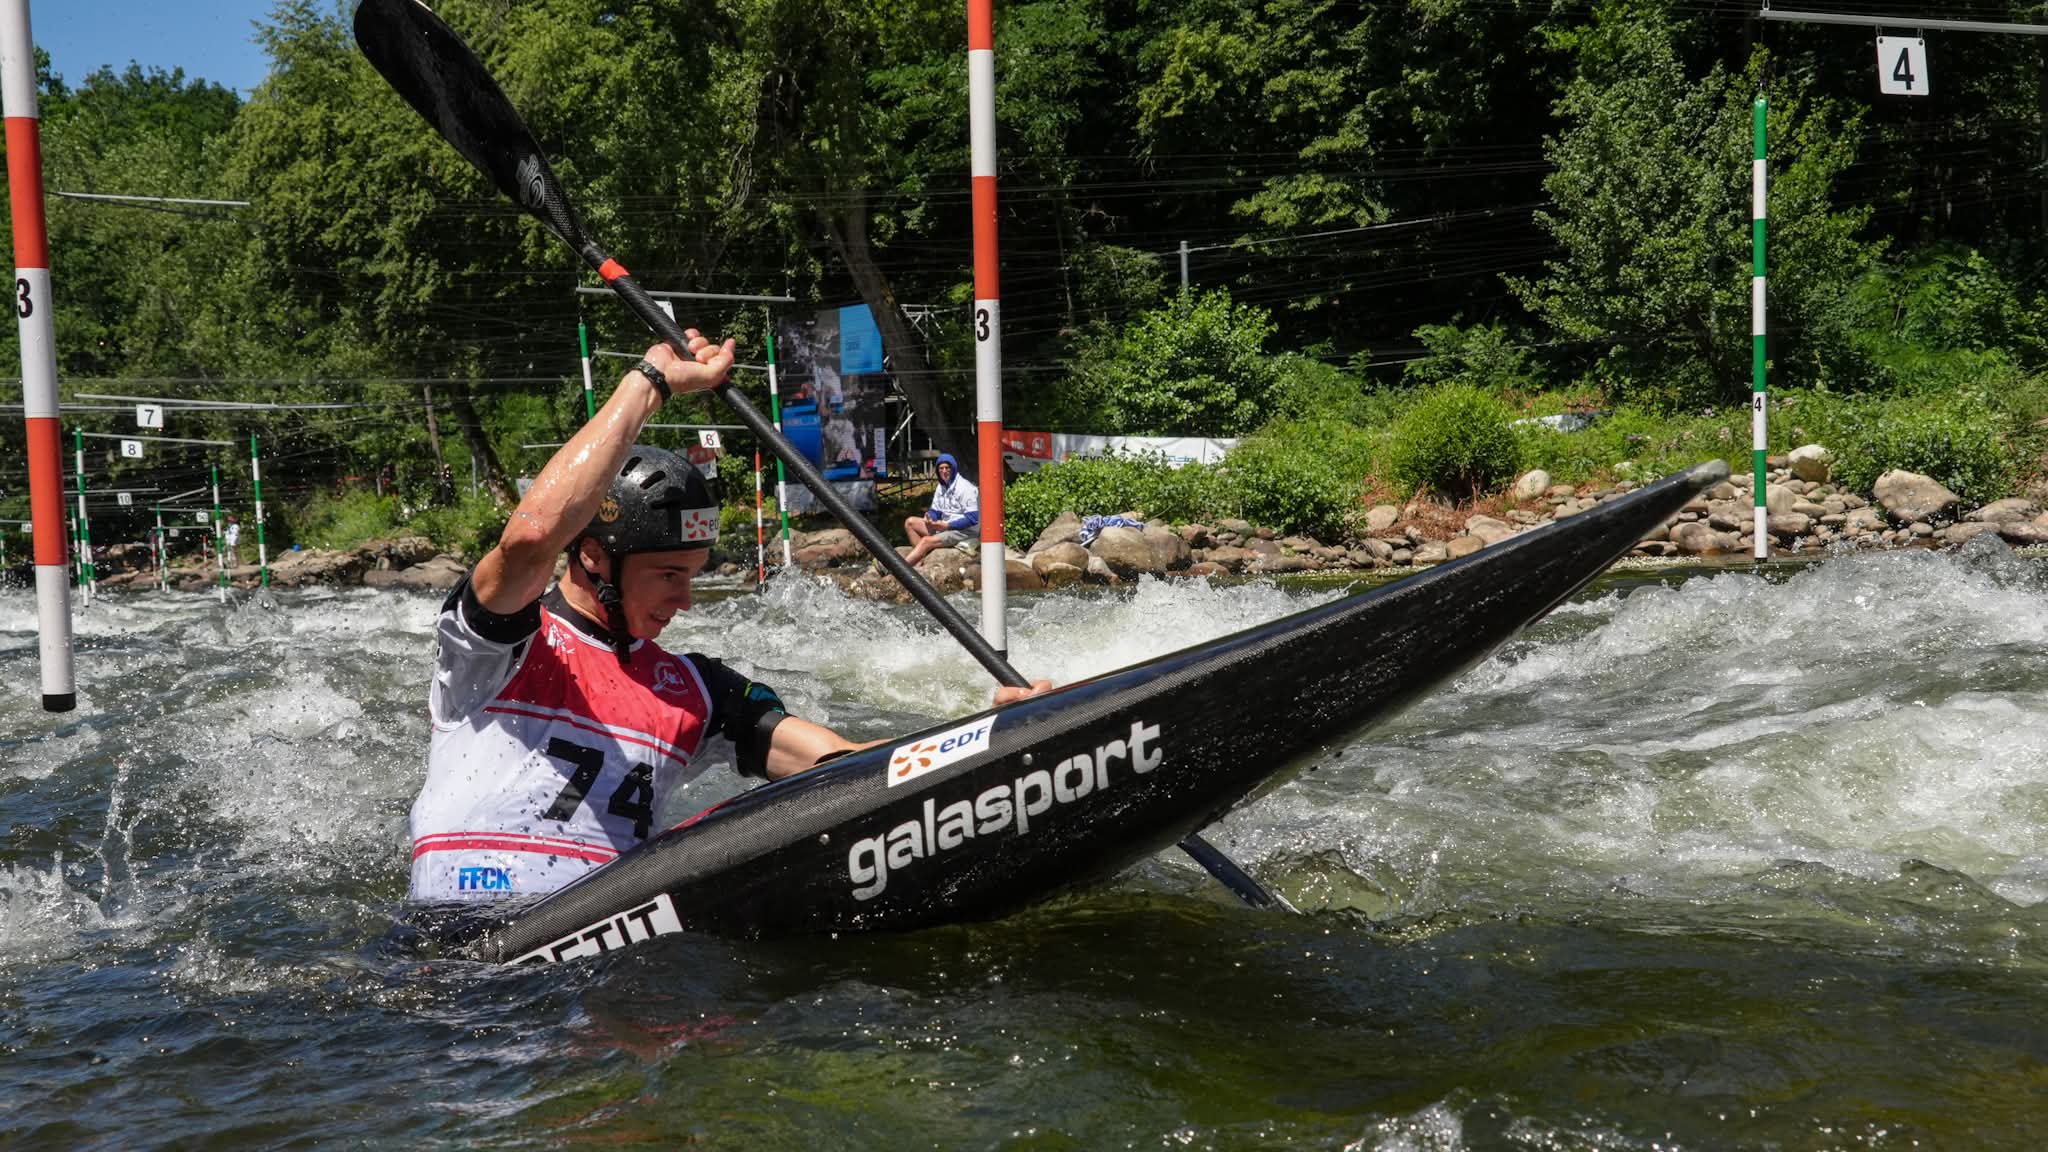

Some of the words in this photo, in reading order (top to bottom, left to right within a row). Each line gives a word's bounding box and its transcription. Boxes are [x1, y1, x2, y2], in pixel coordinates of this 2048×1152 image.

[1893, 47, 1915, 90] 4
[16, 277, 33, 319] 3
[976, 308, 990, 342] 3
[144, 408, 155, 425] 7
[1754, 397, 1762, 412] 4
[127, 444, 137, 456] 8
[119, 495, 129, 504] 10
[543, 736, 656, 840] 74
[847, 720, 1164, 902] galasport
[458, 866, 513, 890] FFCK
[516, 901, 660, 965] ETIT
